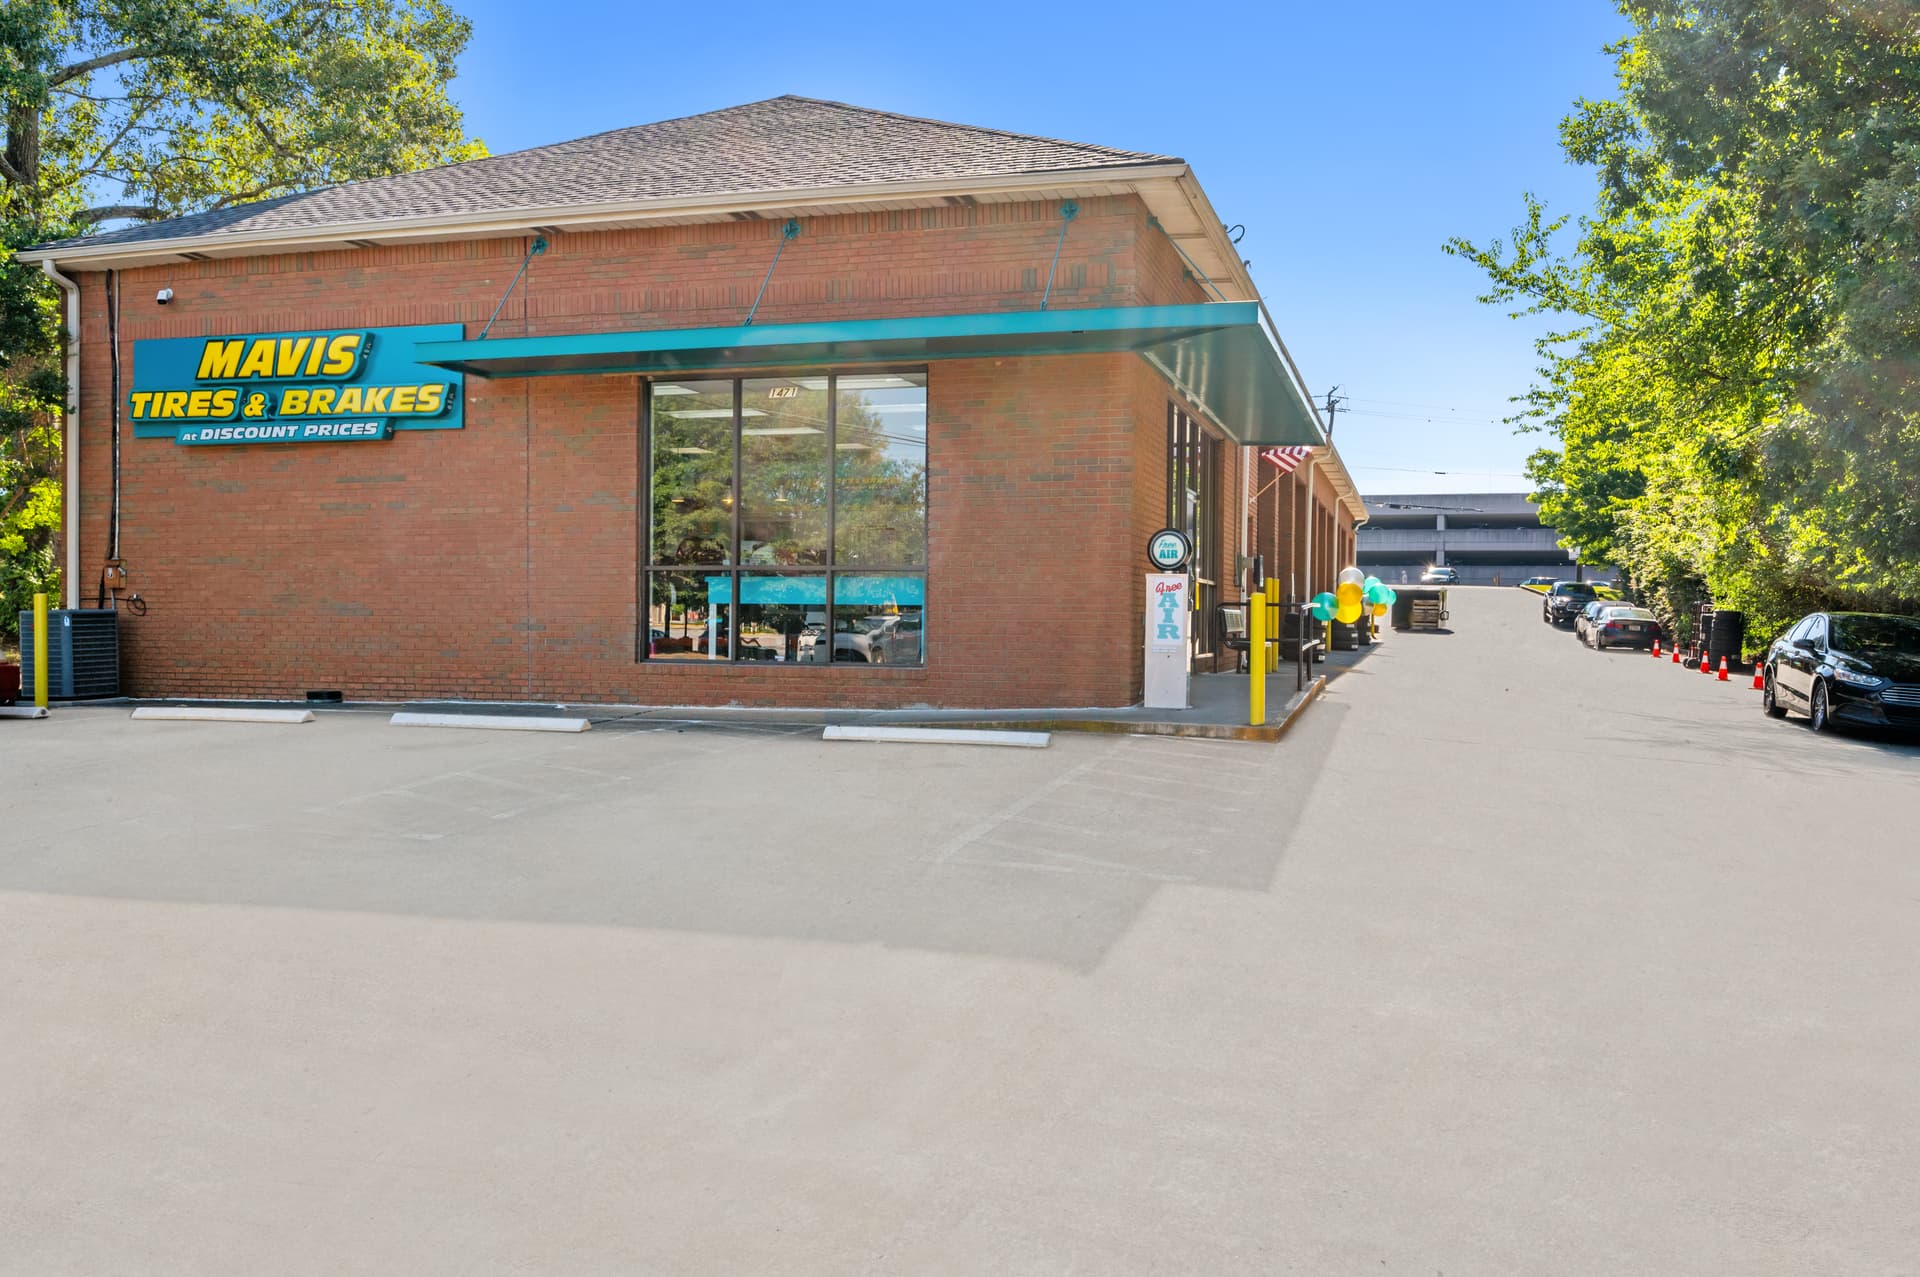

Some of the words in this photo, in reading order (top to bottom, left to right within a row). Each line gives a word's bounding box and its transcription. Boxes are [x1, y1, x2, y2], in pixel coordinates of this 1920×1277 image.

[195, 334, 361, 380] MAVIS
[130, 388, 238, 419] TIRES
[243, 392, 266, 417] &
[279, 383, 446, 416] BRAKES
[199, 425, 299, 441] DISCOUNT
[303, 422, 378, 437] PRICES
[1158, 539, 1177, 549] Free
[1159, 549, 1178, 559] AIR
[1155, 581, 1183, 596] Free
[1157, 592, 1180, 640] AIR
